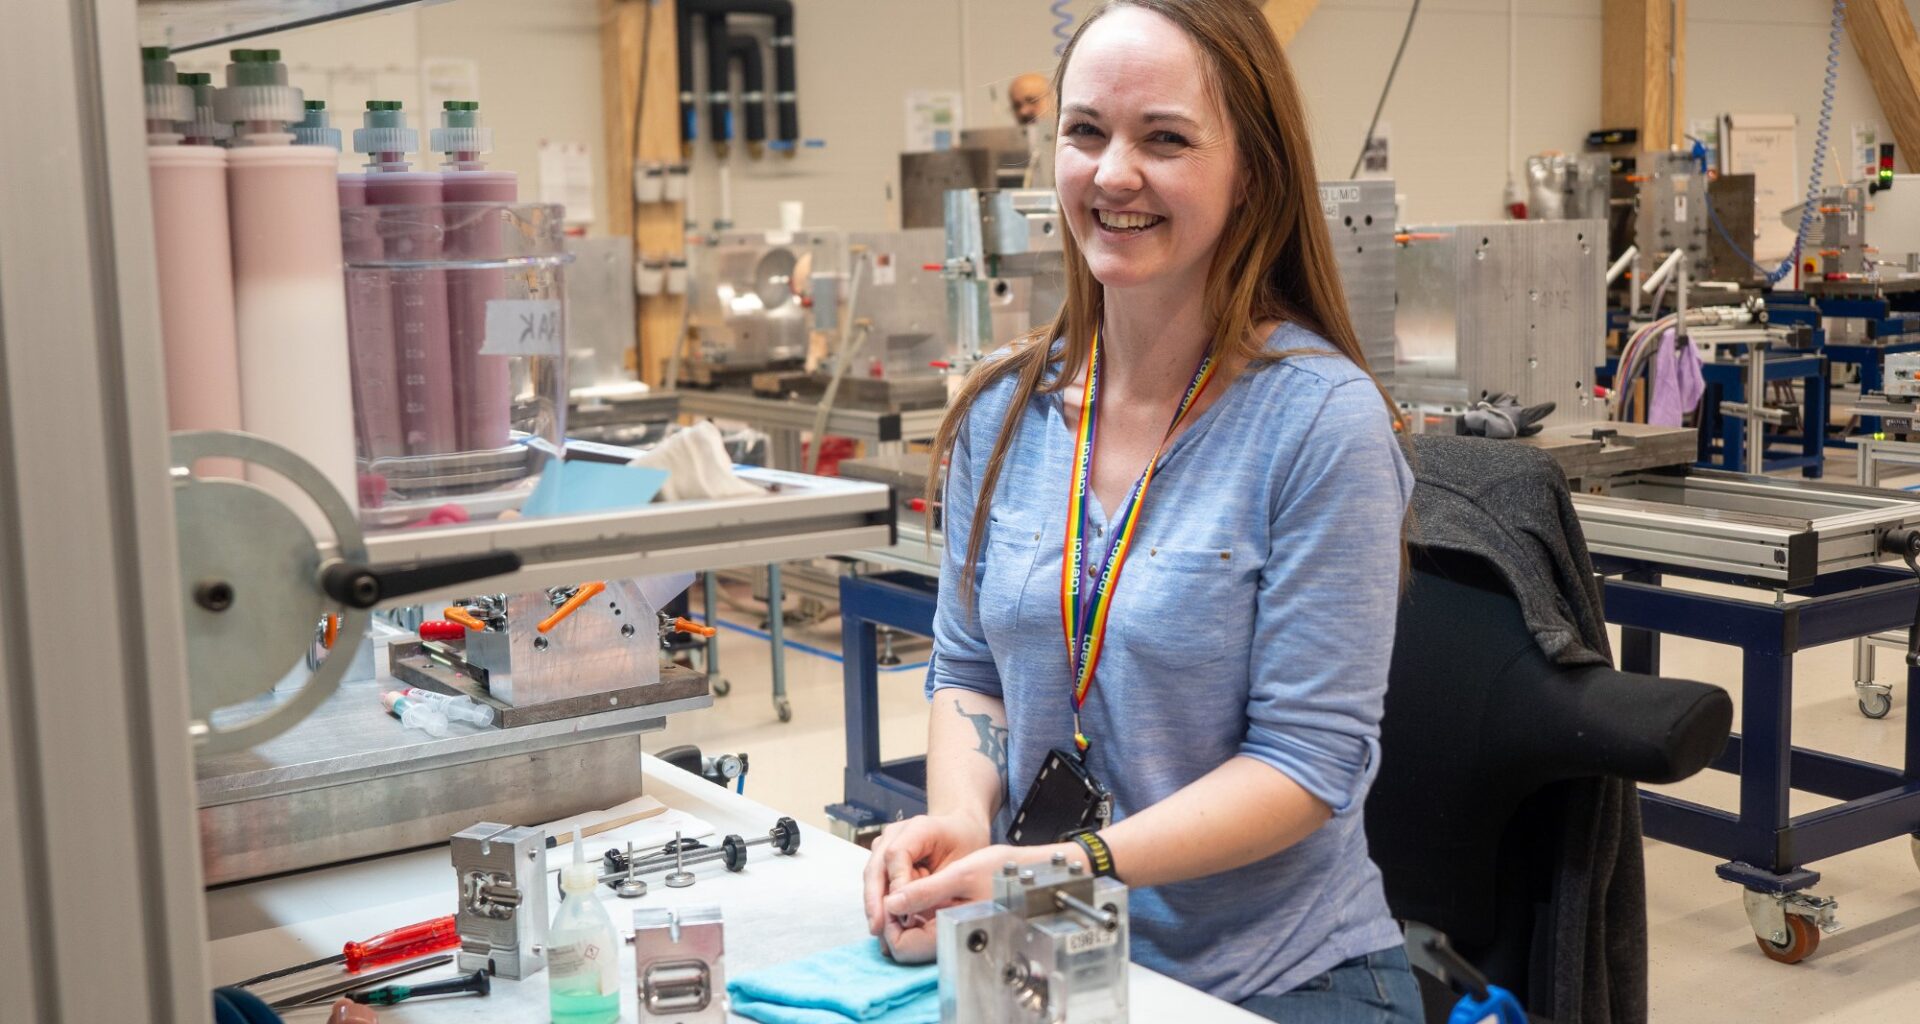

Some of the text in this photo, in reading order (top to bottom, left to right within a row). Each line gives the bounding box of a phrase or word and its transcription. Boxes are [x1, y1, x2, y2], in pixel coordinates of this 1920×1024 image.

[1181, 356, 1213, 410] Laerdal
[1076, 441, 1091, 496] Laerdal
[1069, 538, 1082, 595] Laerdal
[1097, 538, 1125, 597] Laerdal
